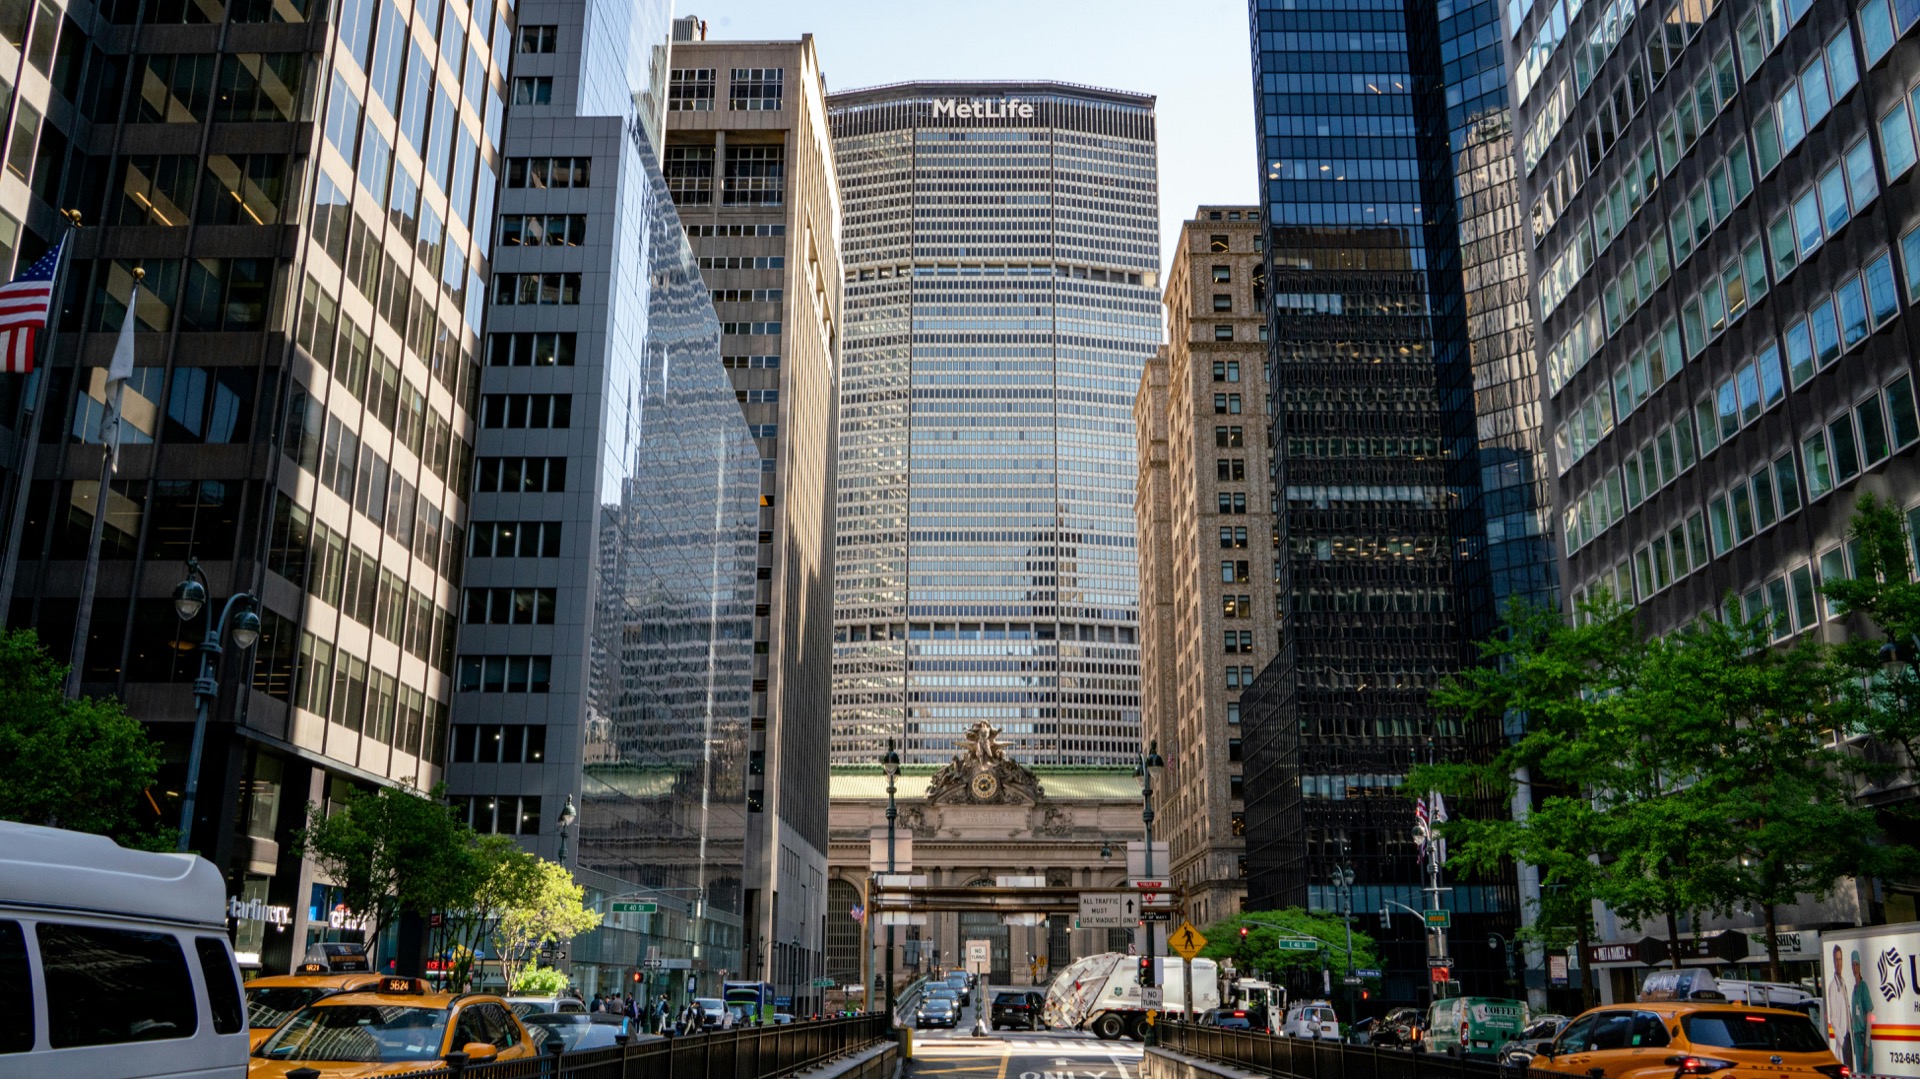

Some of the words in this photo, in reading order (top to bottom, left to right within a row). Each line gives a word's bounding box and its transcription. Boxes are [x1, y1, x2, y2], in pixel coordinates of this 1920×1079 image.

[932, 99, 1035, 119] MetLife
[389, 981, 409, 991] 5B24
[1484, 1006, 1519, 1015] COFFEE
